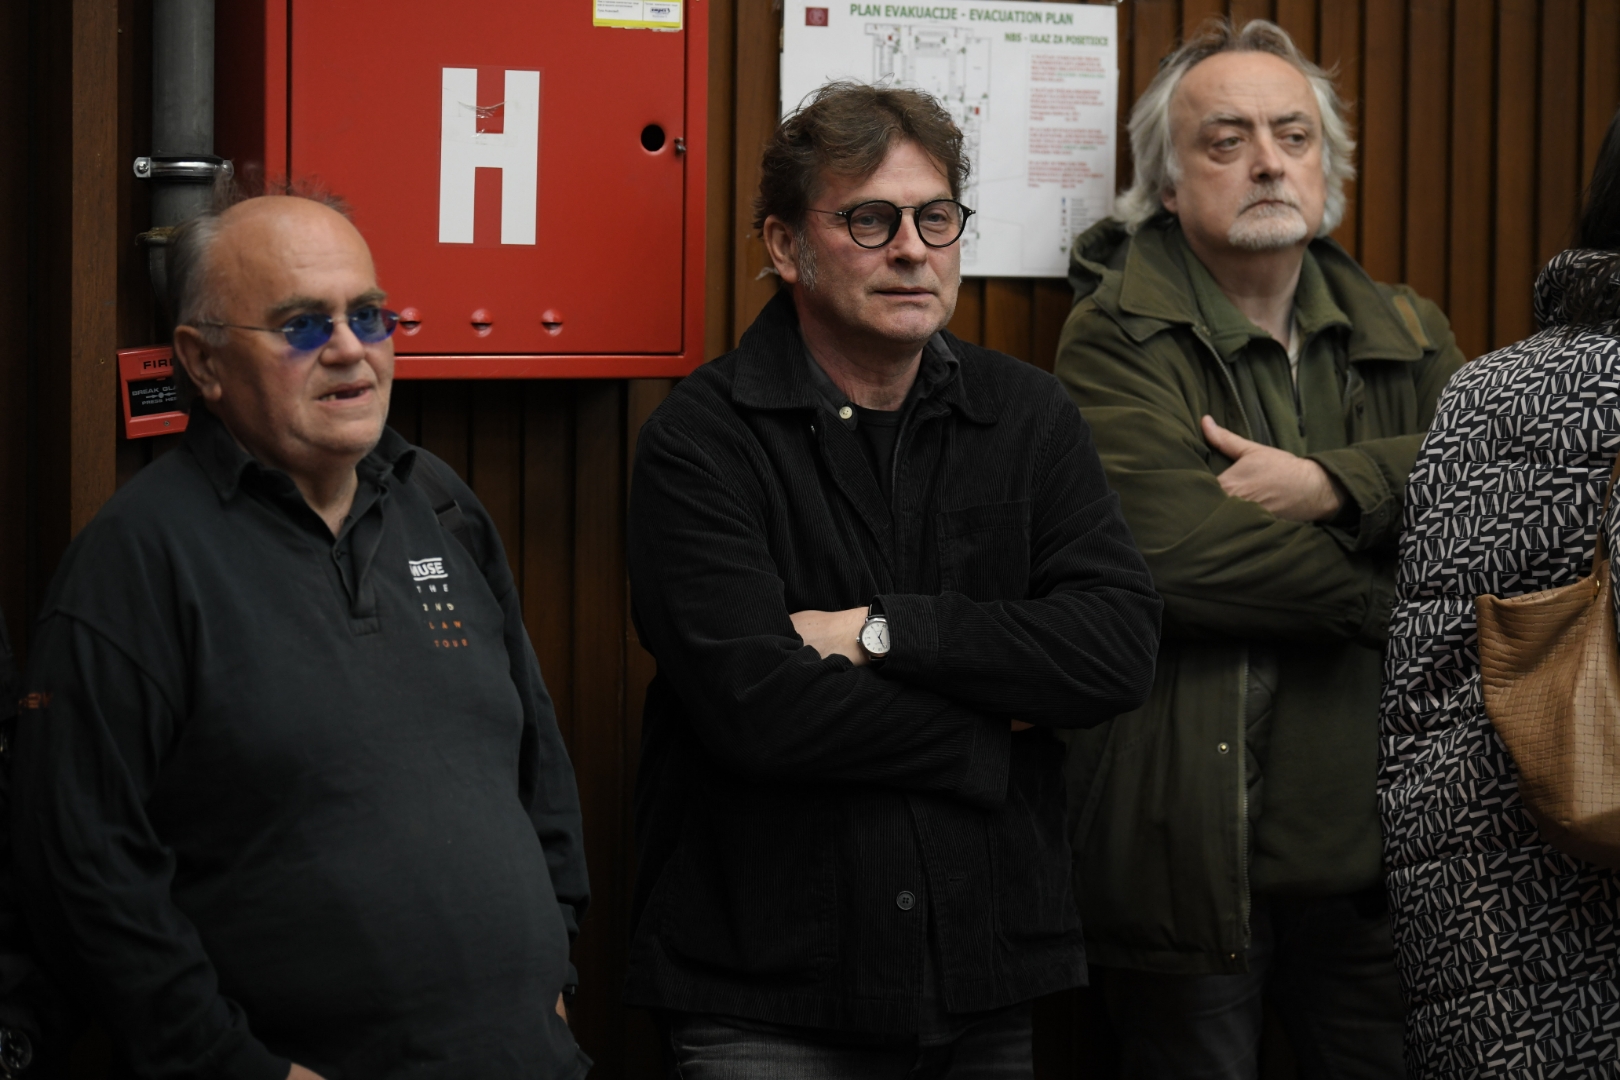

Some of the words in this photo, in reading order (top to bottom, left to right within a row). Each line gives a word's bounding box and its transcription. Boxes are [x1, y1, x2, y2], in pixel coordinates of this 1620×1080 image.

[850, 3, 880, 16] PLAN
[885, 5, 957, 20] EVAKUACIJE
[969, 8, 1042, 23] EVACUATION
[1045, 12, 1074, 25] PLAN
[438, 67, 540, 246] H
[132, 388, 160, 396] BREAK
[409, 562, 445, 577] MUSE
